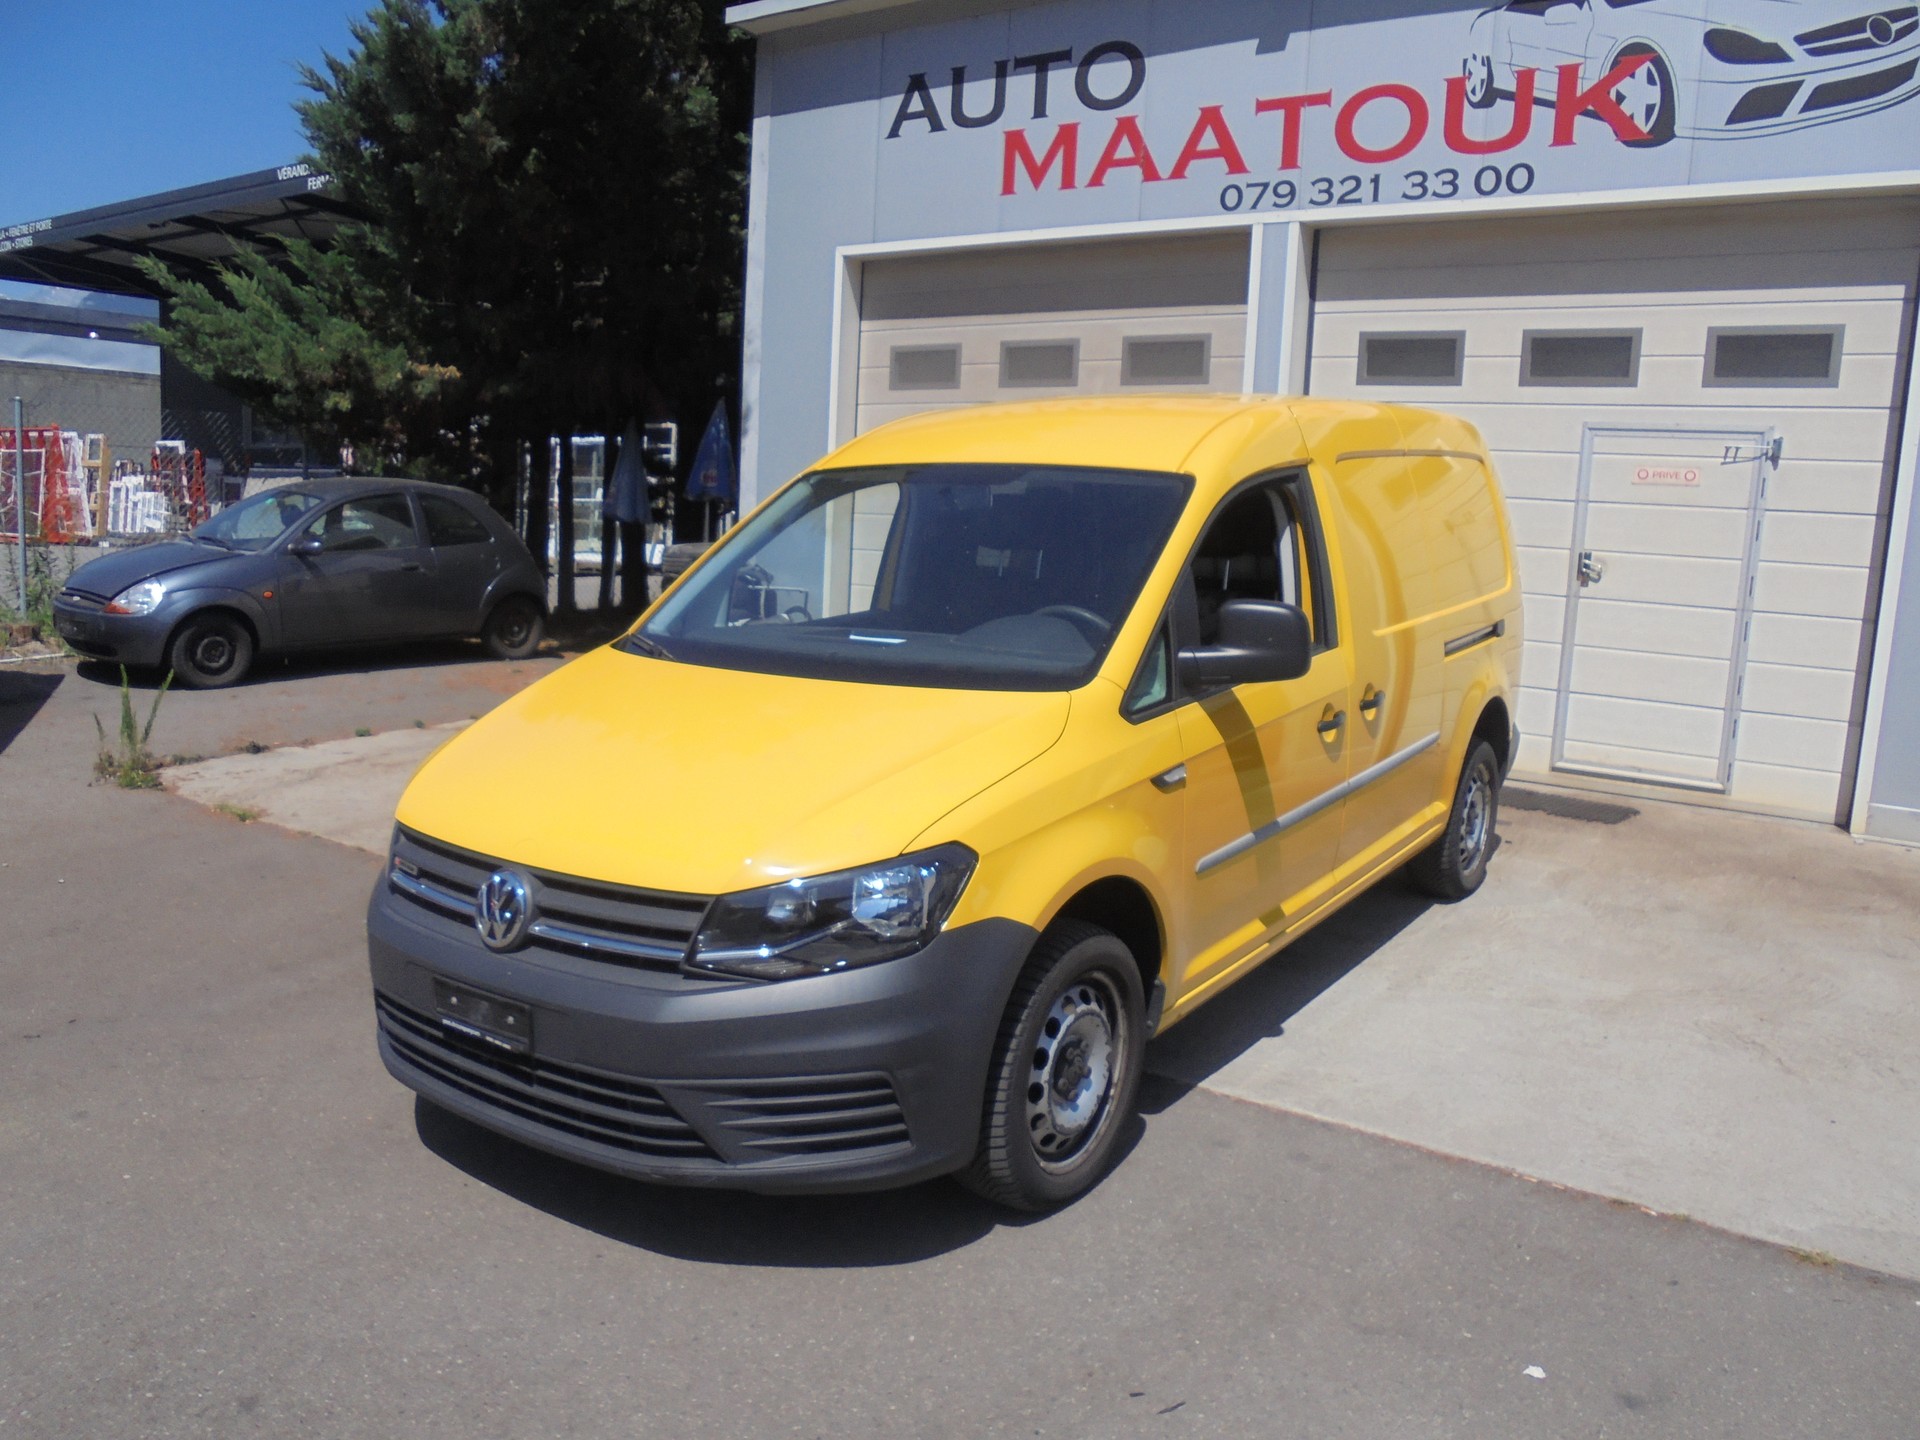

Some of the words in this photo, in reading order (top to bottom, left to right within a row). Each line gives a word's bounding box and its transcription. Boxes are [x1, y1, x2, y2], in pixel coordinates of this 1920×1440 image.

[885, 40, 1146, 139] AUTO
[1000, 53, 1658, 196] MAATOUK
[1219, 180, 1297, 212] 079
[1309, 173, 1381, 206] 321
[1401, 168, 1460, 201] 33
[1474, 162, 1536, 196] 00
